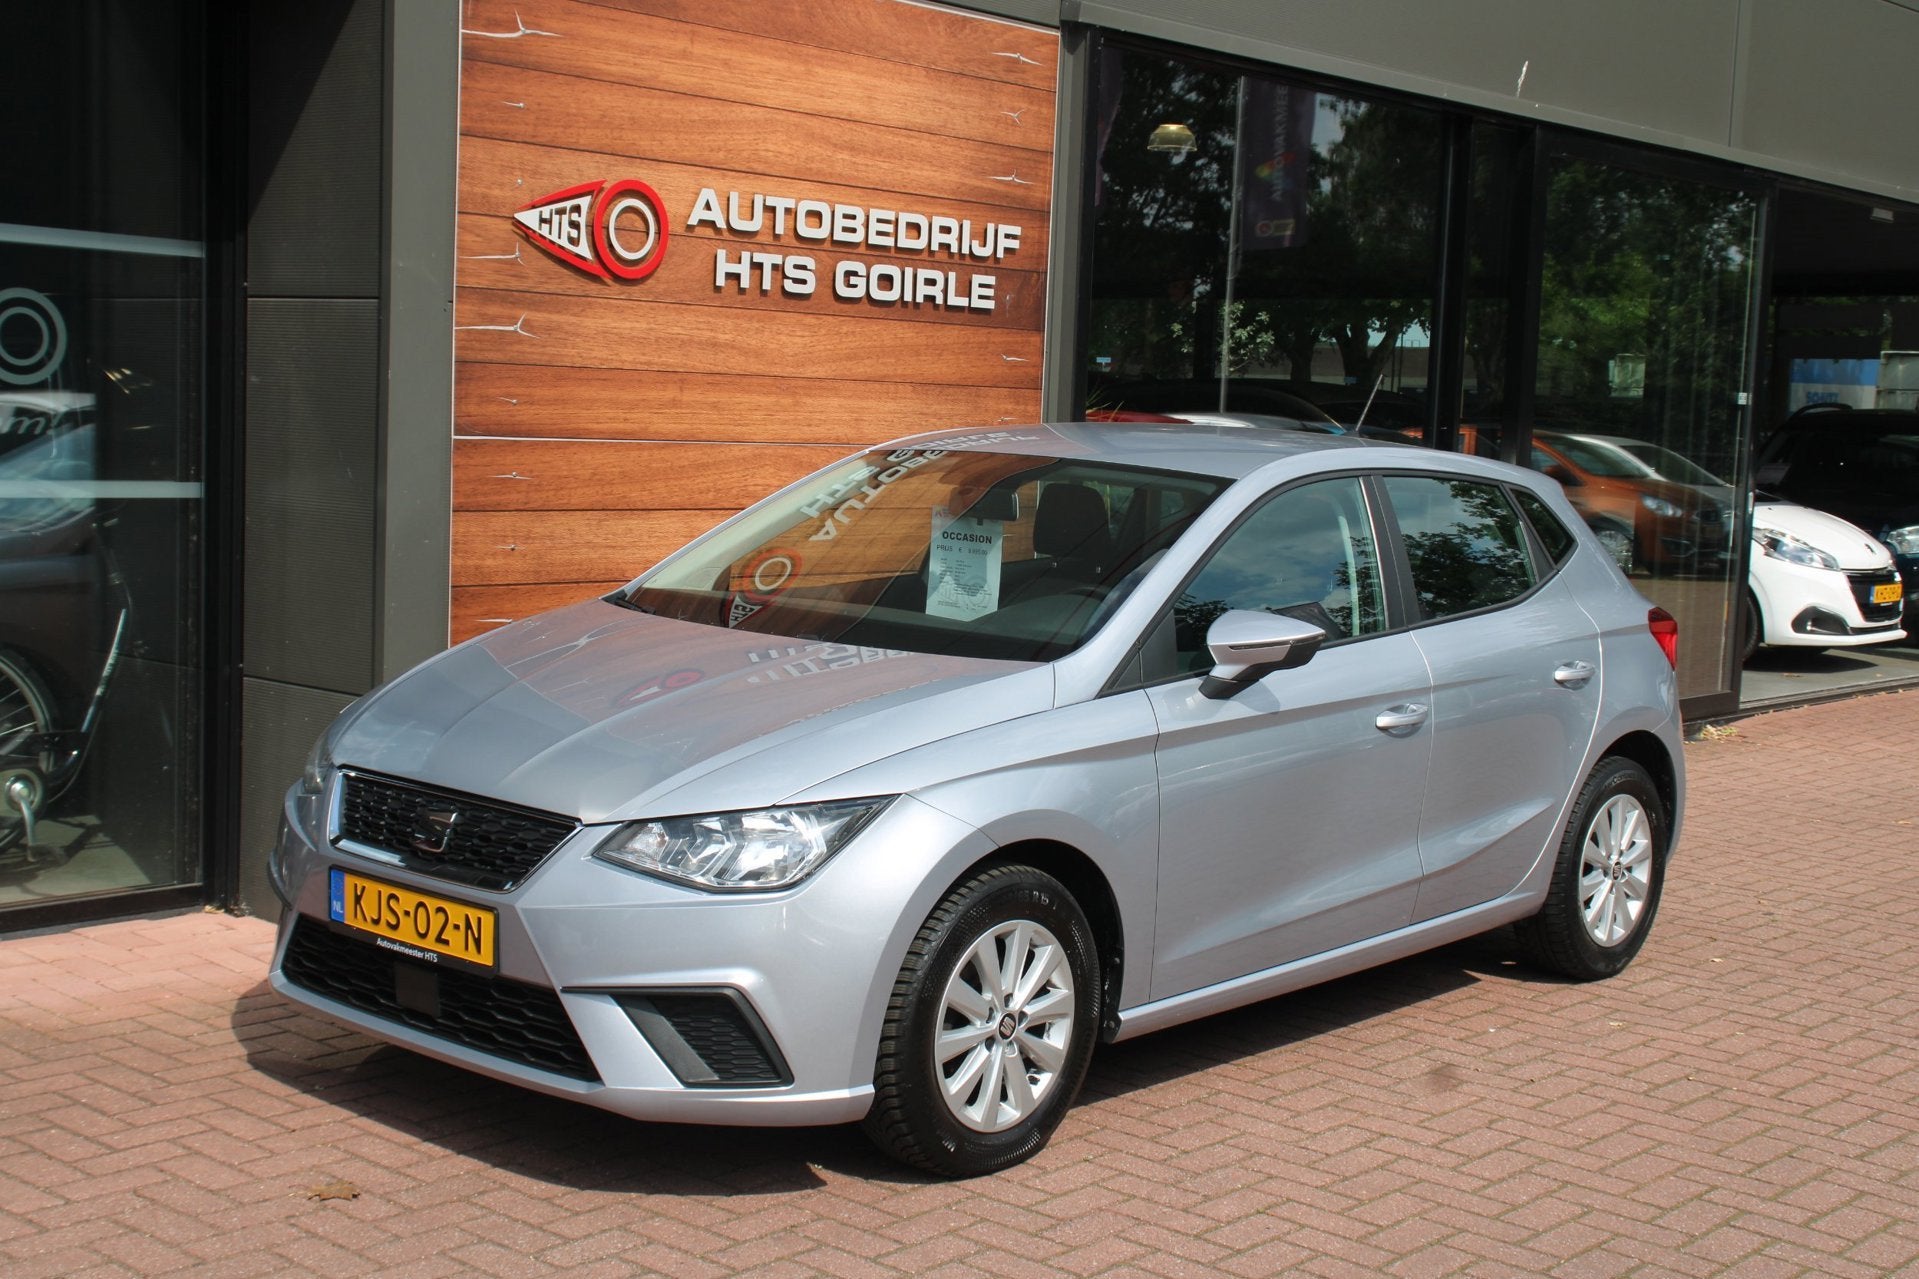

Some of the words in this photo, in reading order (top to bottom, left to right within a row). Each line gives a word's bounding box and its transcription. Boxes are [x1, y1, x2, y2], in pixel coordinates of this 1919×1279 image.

[539, 203, 582, 248] HTS
[687, 188, 1022, 259] AUTOBEDRIJF
[715, 249, 816, 295] HTS
[835, 261, 996, 310] GOIRLE
[942, 531, 992, 544] OCCASION
[332, 901, 344, 914] NL
[353, 883, 482, 954] KJS-02-N
[376, 937, 424, 959] Autovakmeester
[424, 951, 438, 963] HTS
